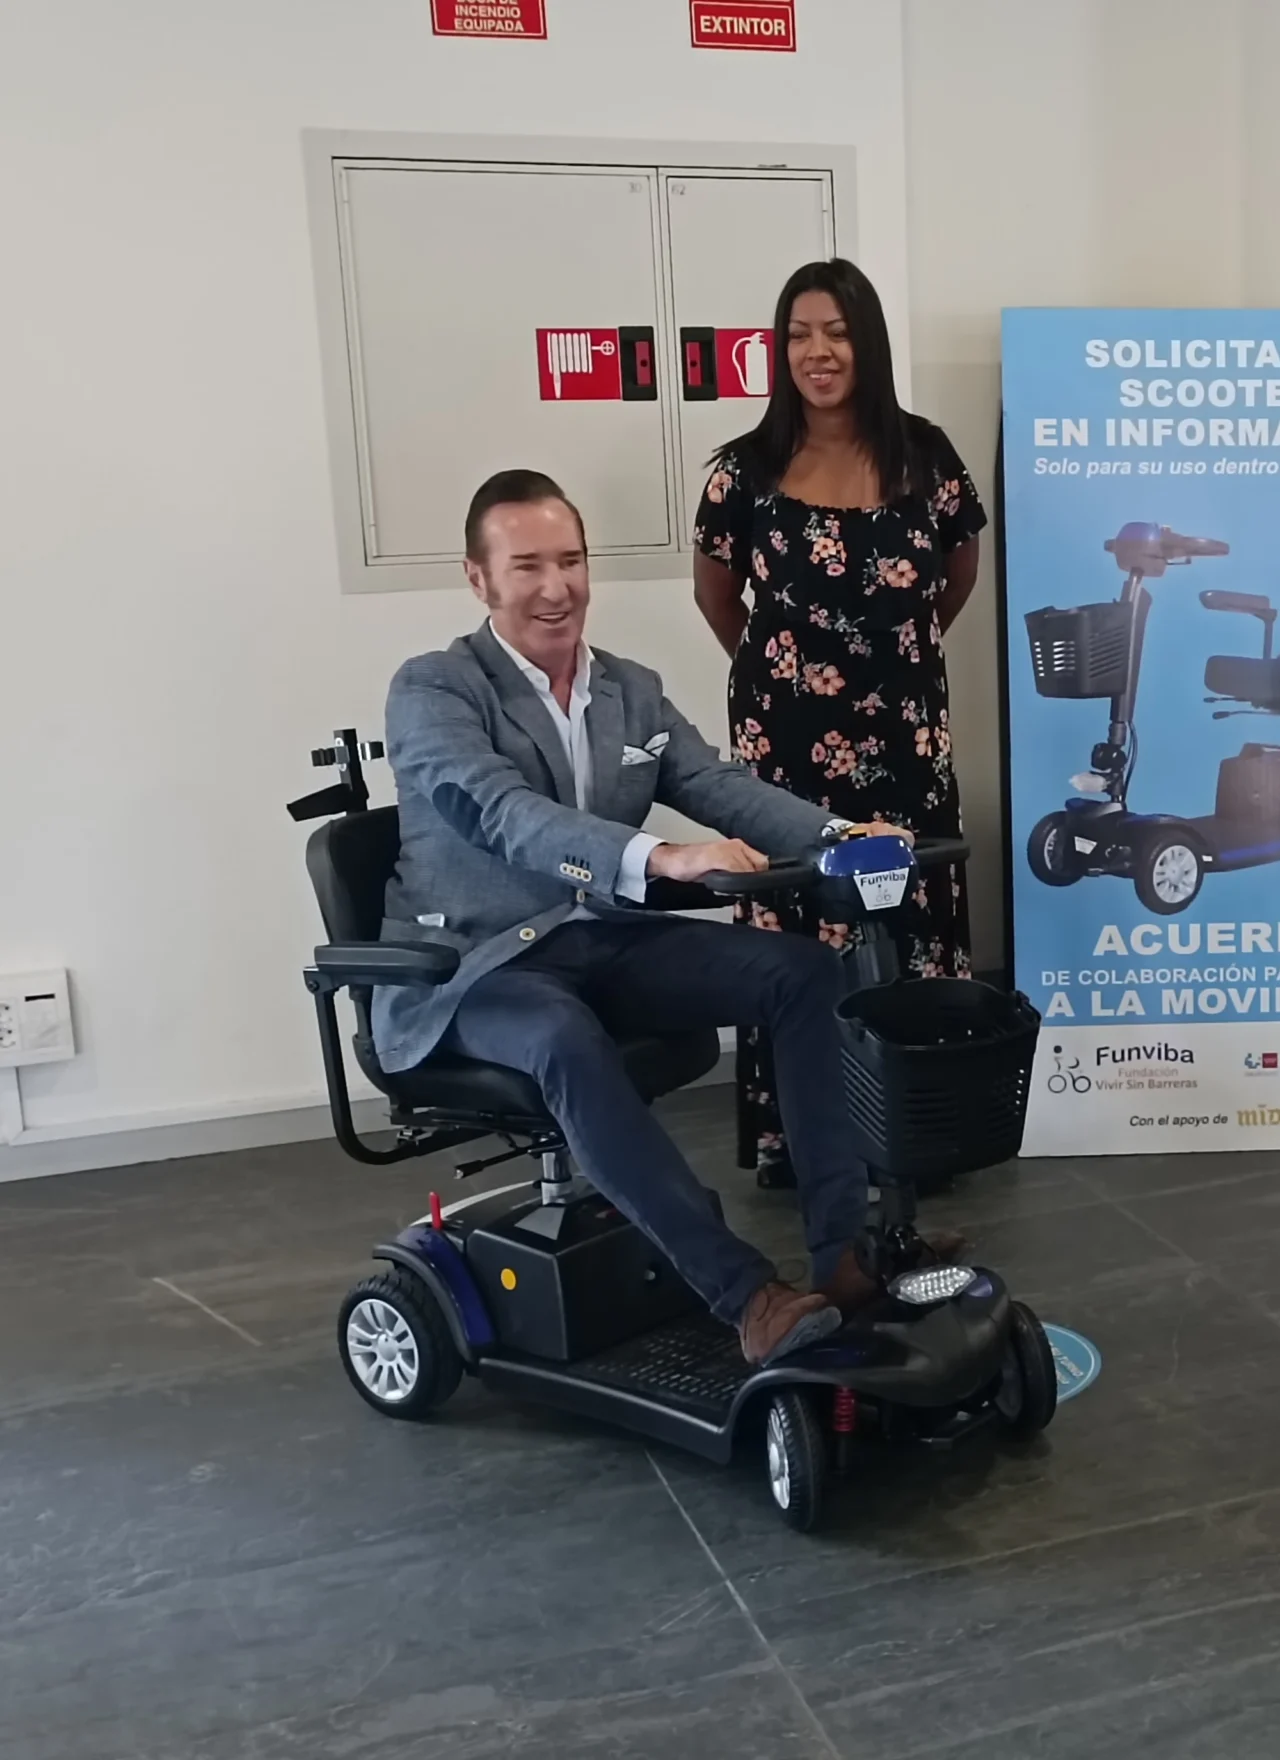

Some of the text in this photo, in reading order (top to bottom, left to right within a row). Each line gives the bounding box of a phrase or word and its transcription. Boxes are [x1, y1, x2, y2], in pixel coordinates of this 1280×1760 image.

[455, 5, 521, 18] INCENDIO
[454, 18, 525, 32] EQUIPADA
[700, 15, 786, 36] EXTINTOR
[1034, 418, 1089, 447] EN
[1034, 457, 1081, 475] Solo
[1086, 461, 1131, 479] para
[1138, 461, 1163, 475] su
[1169, 461, 1207, 475] uso
[1213, 457, 1279, 475] dentro
[860, 872, 906, 888] Funviba
[1041, 970, 1071, 986] DE
[1078, 963, 1256, 985] COLABORACIÓN
[1045, 991, 1076, 1018] A
[1091, 990, 1146, 1017] LA
[1095, 1042, 1195, 1066] Funviba
[1118, 1067, 1179, 1078] Fundación
[1095, 1078, 1198, 1090] Vivir Sin Barreras
[1129, 1115, 1154, 1127] Con
[1158, 1115, 1169, 1126] el
[1172, 1116, 1210, 1127] apoyo
[1212, 1113, 1228, 1124] de
